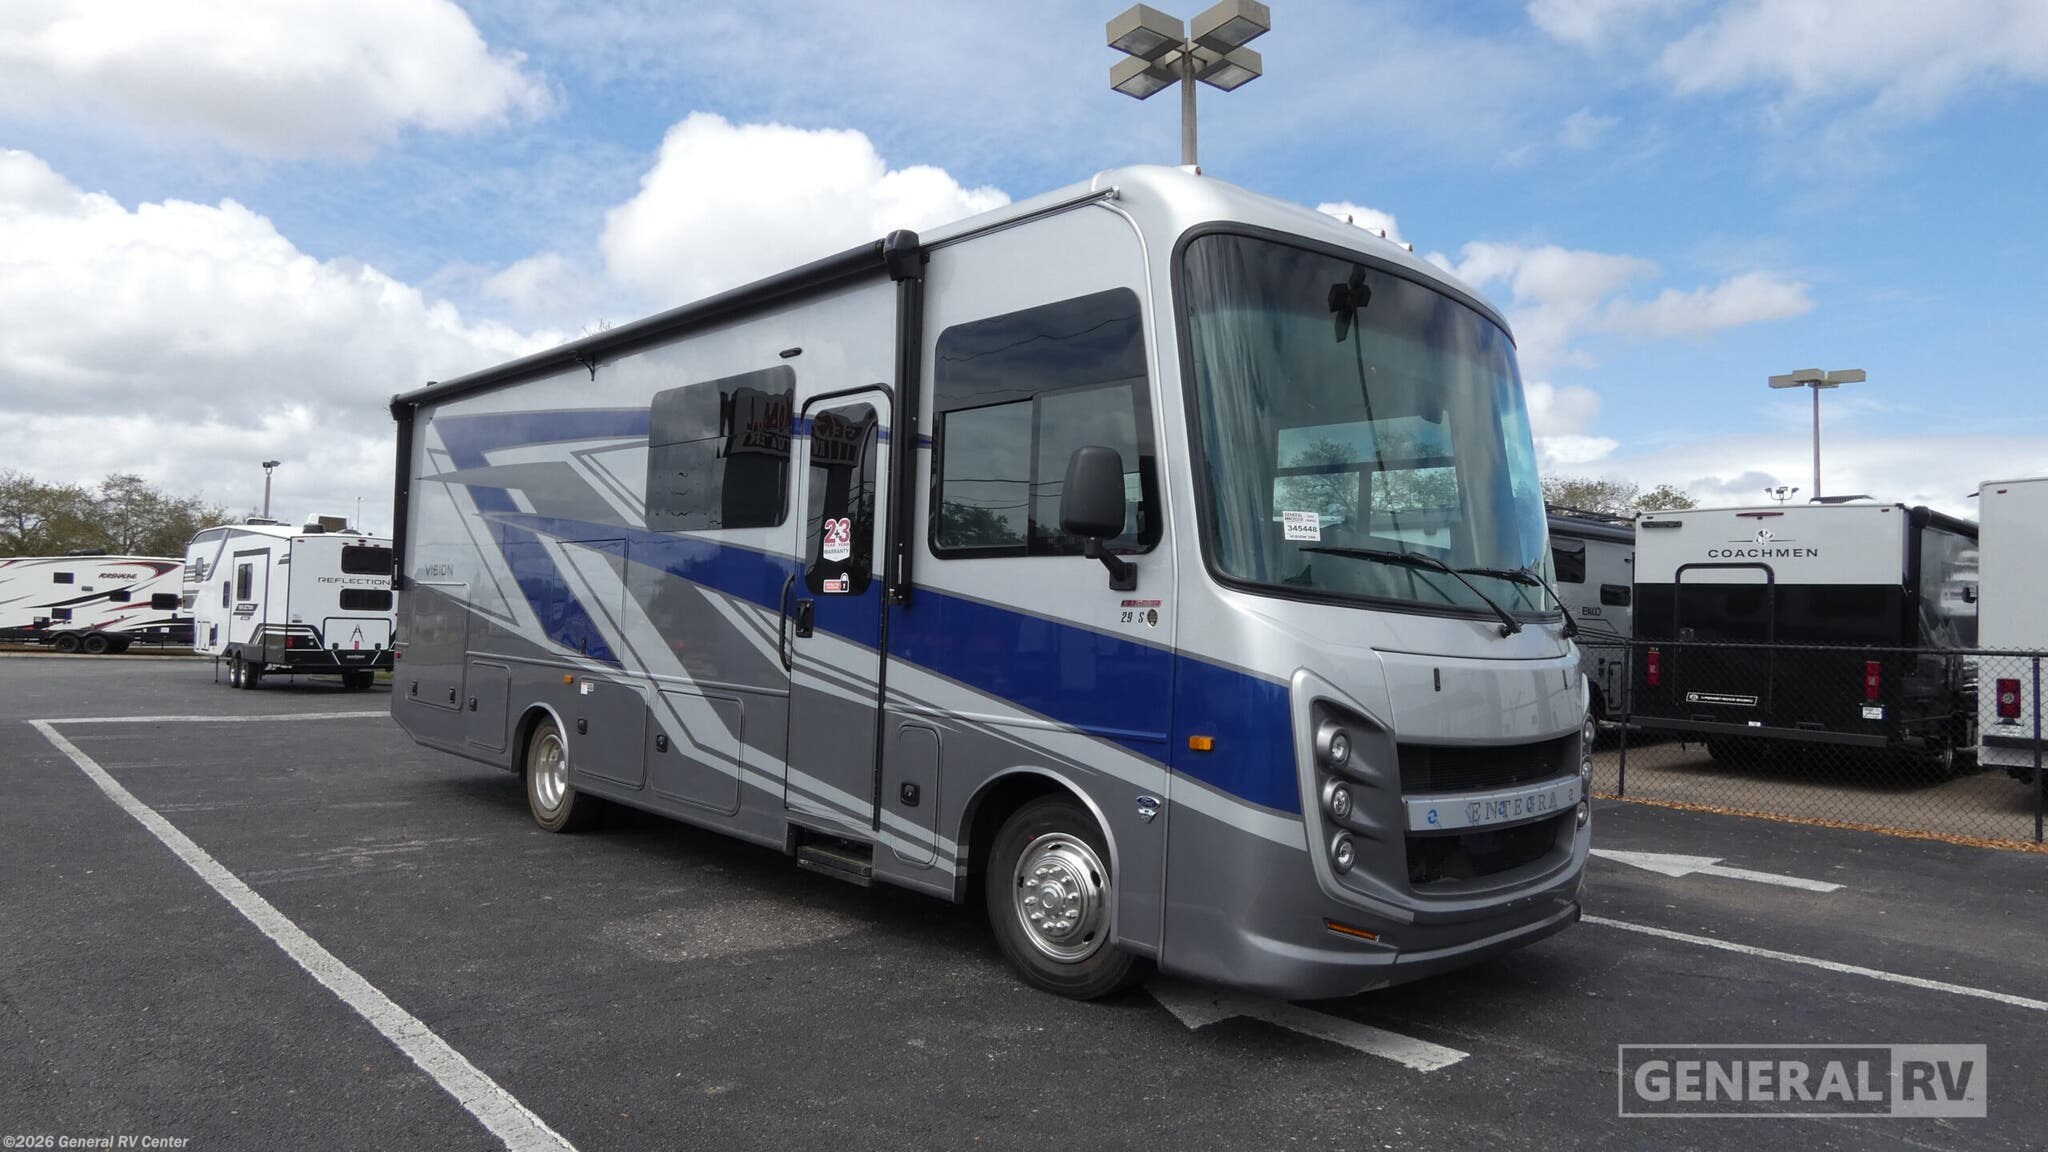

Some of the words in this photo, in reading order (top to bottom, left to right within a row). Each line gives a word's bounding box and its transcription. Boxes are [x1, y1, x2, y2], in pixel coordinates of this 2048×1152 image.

[1707, 548, 1818, 558] COACHMEN
[425, 563, 454, 577] VISION
[317, 576, 391, 586] REFLECTION
[1120, 611, 1133, 623] 29
[1137, 611, 1145, 623] S
[1469, 791, 1558, 823] ENTEGRA
